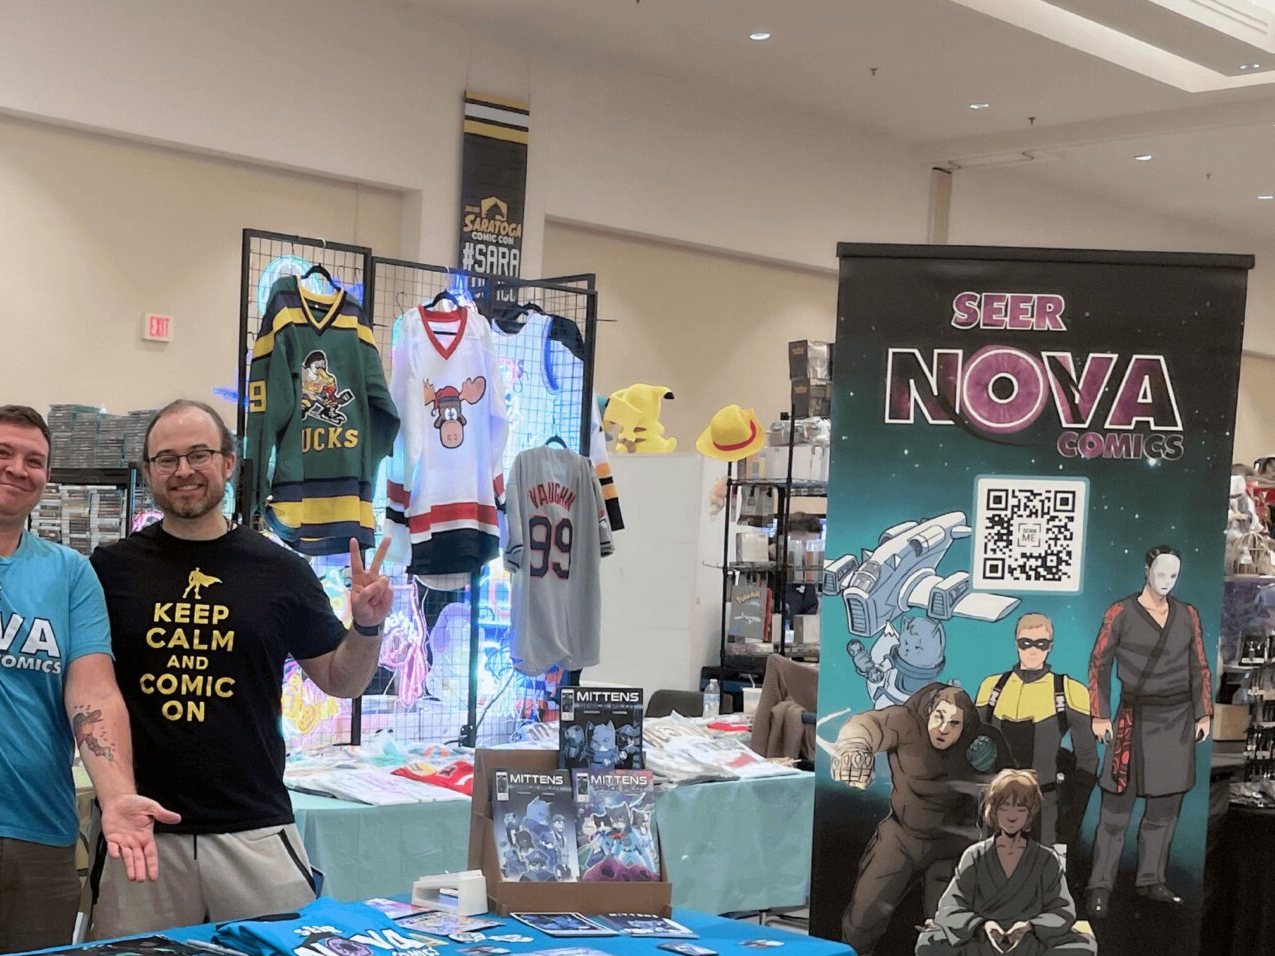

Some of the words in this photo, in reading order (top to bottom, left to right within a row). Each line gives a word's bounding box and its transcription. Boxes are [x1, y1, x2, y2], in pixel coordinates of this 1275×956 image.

[463, 214, 522, 238] SARATOGA
[471, 231, 497, 243] COMIC
[498, 234, 515, 245] CON
[462, 242, 520, 278] #SARA
[951, 291, 1067, 332] SEER
[149, 315, 170, 338] EXIT
[883, 345, 1184, 433] NOVA
[301, 426, 359, 453] UCKS
[1056, 430, 1185, 460] COMICS
[528, 482, 577, 512] VAUGHN
[528, 514, 574, 580] 99
[153, 602, 230, 626] KEEP
[145, 627, 236, 653] CALM
[166, 654, 210, 671] AND
[139, 672, 237, 699] COMIC
[576, 691, 640, 702] MITTENS
[161, 700, 206, 723] ON
[509, 774, 564, 785] MITTENS
[590, 774, 648, 785] MITTENS
